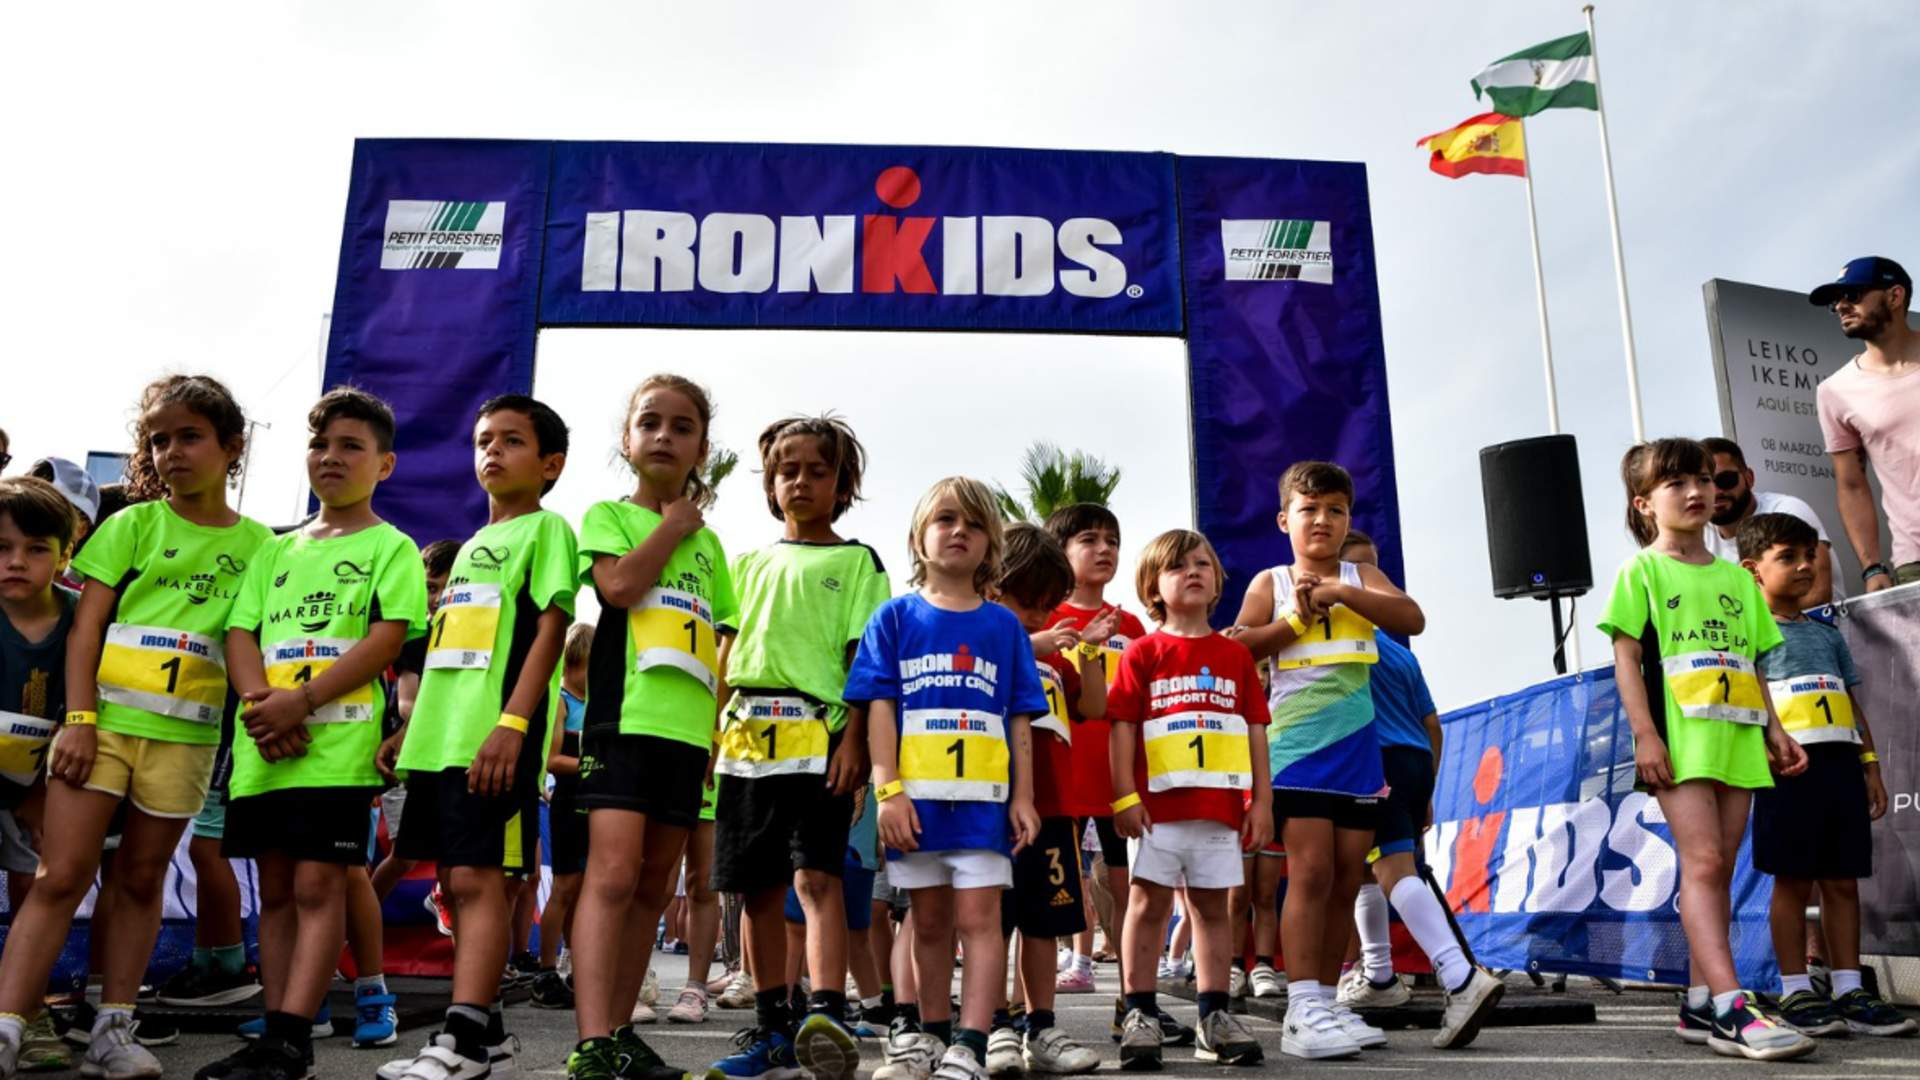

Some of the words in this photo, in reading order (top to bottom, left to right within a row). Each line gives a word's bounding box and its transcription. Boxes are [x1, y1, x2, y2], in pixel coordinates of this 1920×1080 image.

[388, 231, 427, 244] PETIT
[427, 232, 501, 246] FORESTIER
[581, 166, 1126, 299] IRONKIDS
[1230, 248, 1264, 258] PETIT
[1265, 249, 1332, 261] FORESTIER
[1748, 338, 1818, 366] LEIKO
[1761, 437, 1776, 451] 08
[1779, 441, 1823, 457] MARZO
[1764, 459, 1808, 476] PUERTO
[269, 601, 367, 625] MARBELLA
[434, 612, 447, 648] 1
[684, 619, 697, 654] 1
[1317, 615, 1331, 640] 1
[140, 633, 209, 656] IRONKIDS
[275, 640, 340, 659] IRONKIDS
[160, 656, 182, 693] 1
[902, 675, 963, 696] SUPPORT
[965, 676, 995, 698] CREW
[1718, 672, 1730, 703] 1
[751, 700, 803, 717] ONKIDS
[1151, 693, 1207, 711] SUPPORT
[1815, 695, 1834, 725] 1
[926, 712, 988, 733] IRONKIDS
[1167, 714, 1223, 732] IRONKIDS
[761, 724, 777, 760] 1
[1188, 735, 1205, 769] 1
[946, 738, 965, 779] 1
[1045, 847, 1065, 886] 3
